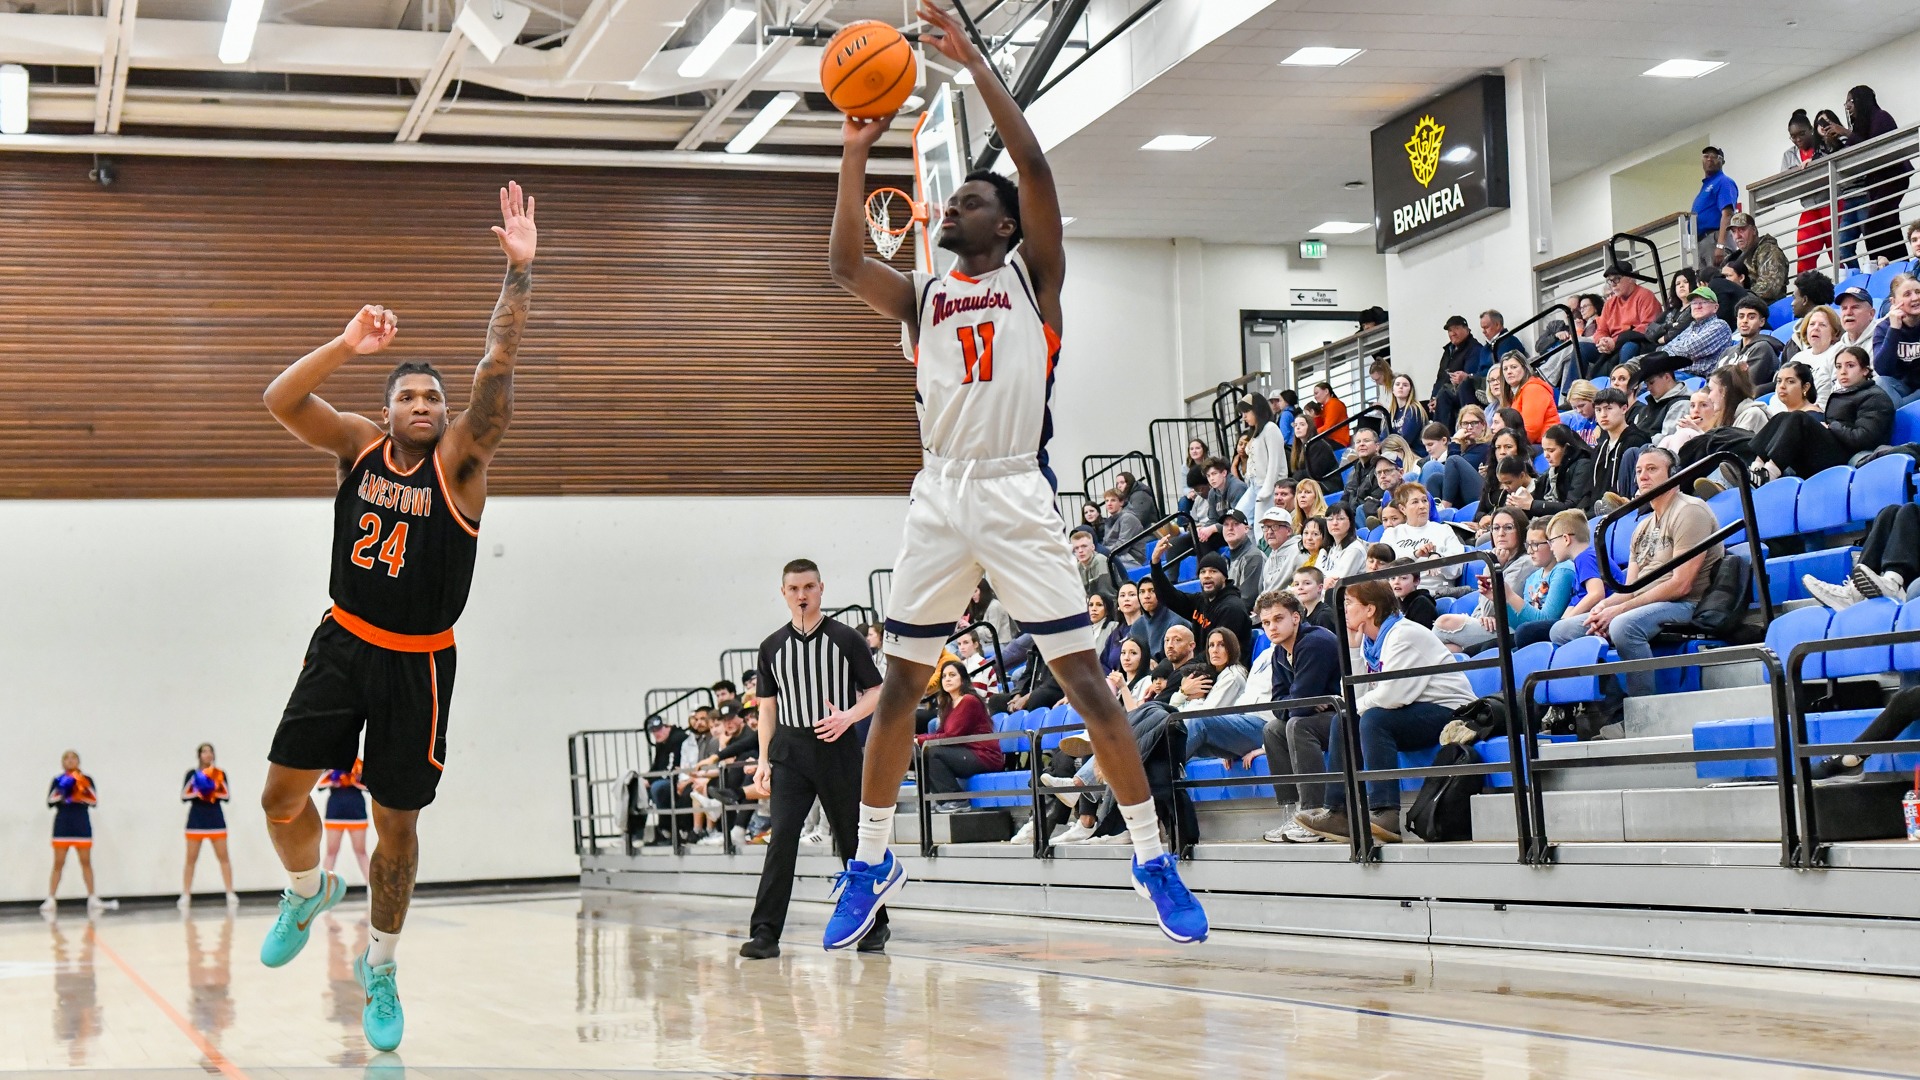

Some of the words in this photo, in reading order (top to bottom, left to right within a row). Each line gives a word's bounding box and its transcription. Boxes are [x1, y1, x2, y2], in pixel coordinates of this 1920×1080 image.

[1393, 183, 1465, 235] BRAVERA
[1305, 243, 1322, 257] EXIT
[932, 288, 1012, 327] Marauders
[956, 321, 995, 385] 11
[350, 511, 409, 578] 24
